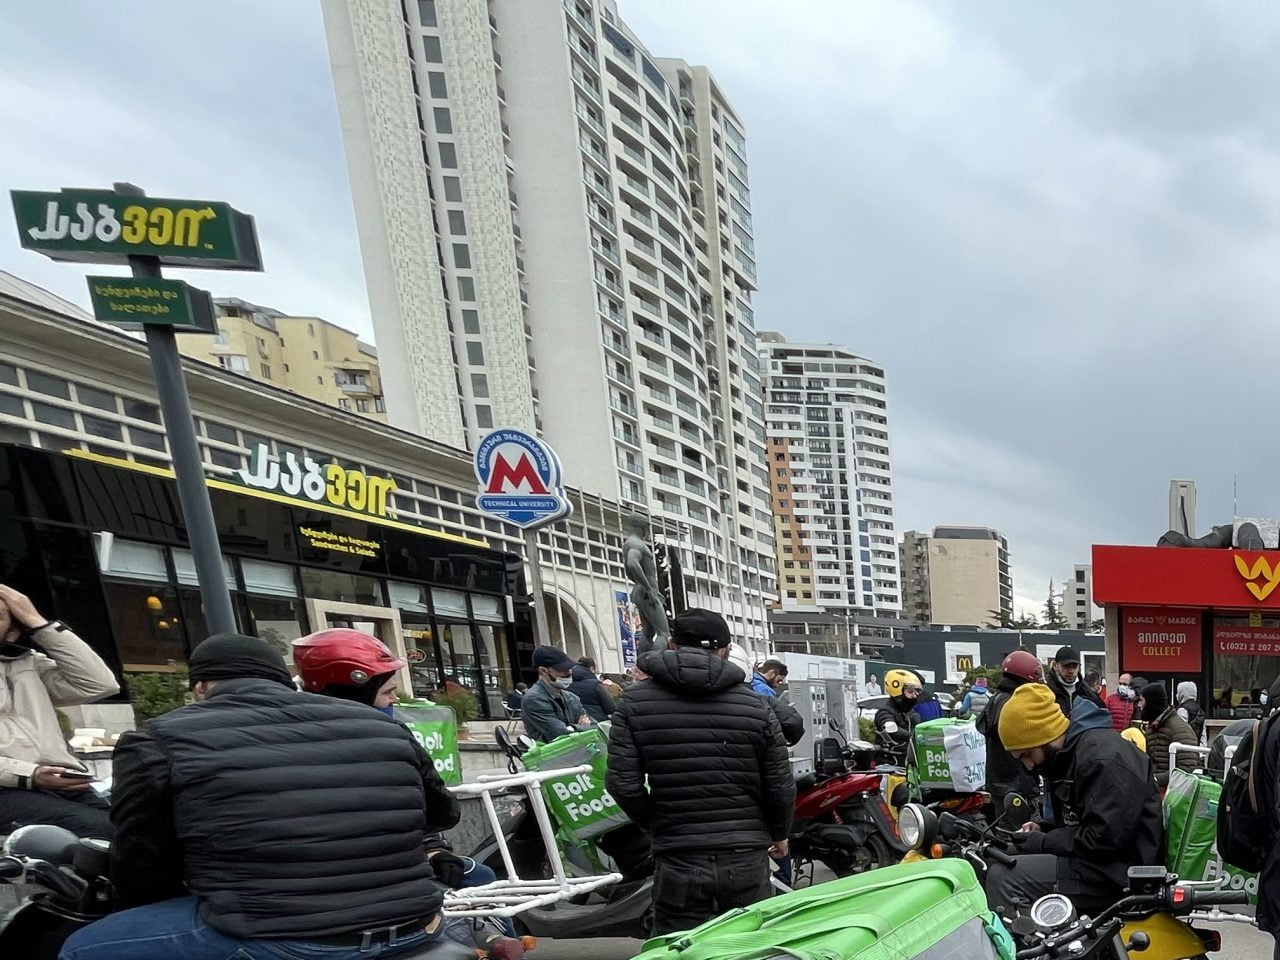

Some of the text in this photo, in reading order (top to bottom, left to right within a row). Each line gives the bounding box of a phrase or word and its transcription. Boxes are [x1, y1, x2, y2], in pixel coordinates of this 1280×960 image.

[1168, 617, 1197, 625] MARGE
[1142, 646, 1181, 656] COLLECT
[433, 753, 454, 772] od
[927, 765, 950, 778] Foo
[552, 774, 595, 801] Bolt
[565, 788, 617, 822] Food
